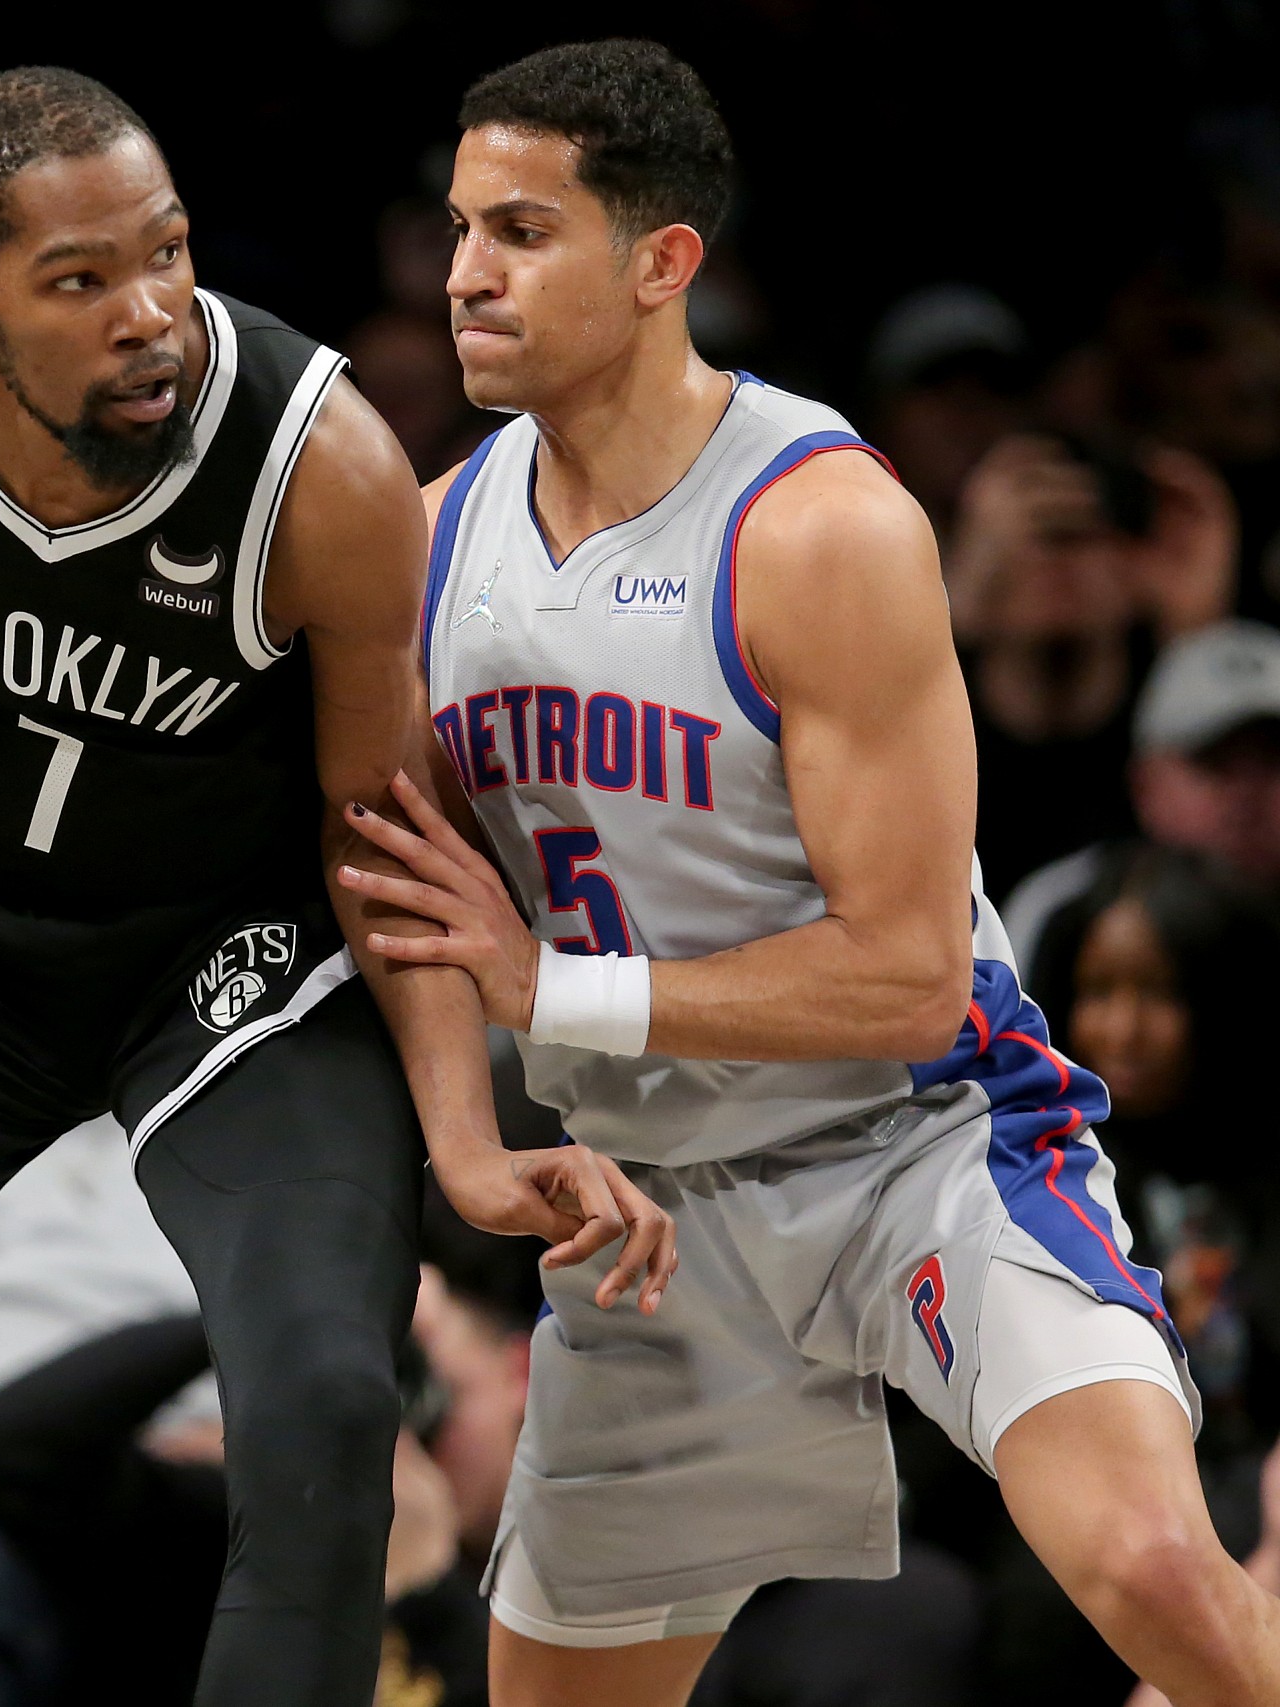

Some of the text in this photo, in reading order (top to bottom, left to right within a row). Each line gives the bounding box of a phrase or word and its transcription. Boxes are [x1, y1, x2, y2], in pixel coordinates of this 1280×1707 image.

[145, 586, 212, 616] Webull
[615, 576, 686, 605] UWM
[18, 714, 84, 853] 7
[431, 685, 721, 811] DETROIT
[532, 826, 634, 957] 5
[195, 925, 289, 1006] NETS
[227, 980, 247, 1019] B
